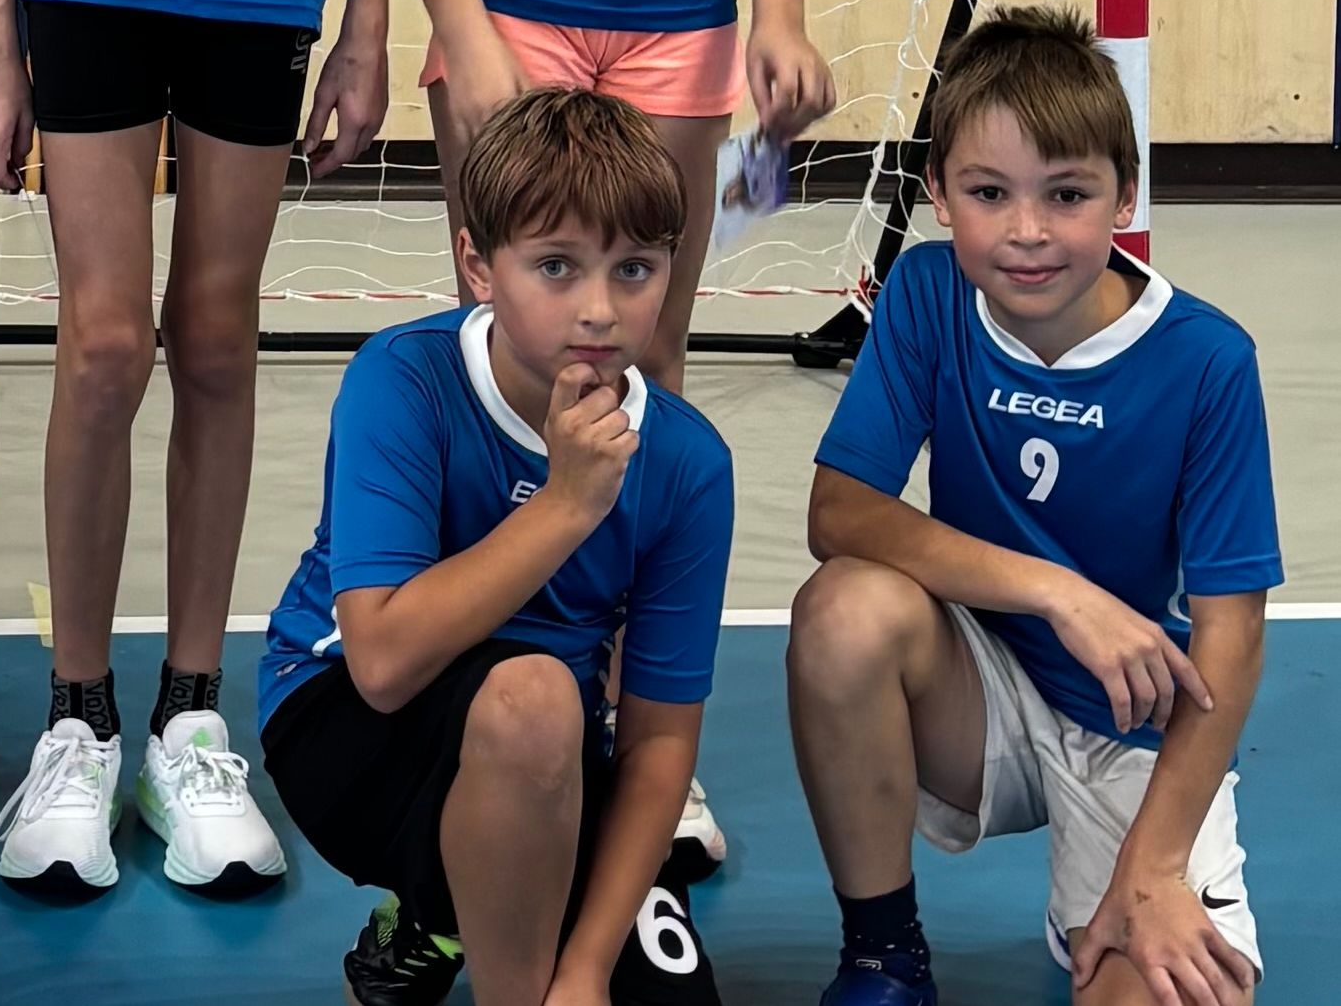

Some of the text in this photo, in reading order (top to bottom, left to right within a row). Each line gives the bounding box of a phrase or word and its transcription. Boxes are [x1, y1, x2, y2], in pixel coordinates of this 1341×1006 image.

[986, 388, 1104, 429] LEGEA
[1020, 437, 1060, 503] 9
[636, 886, 698, 974] 6
